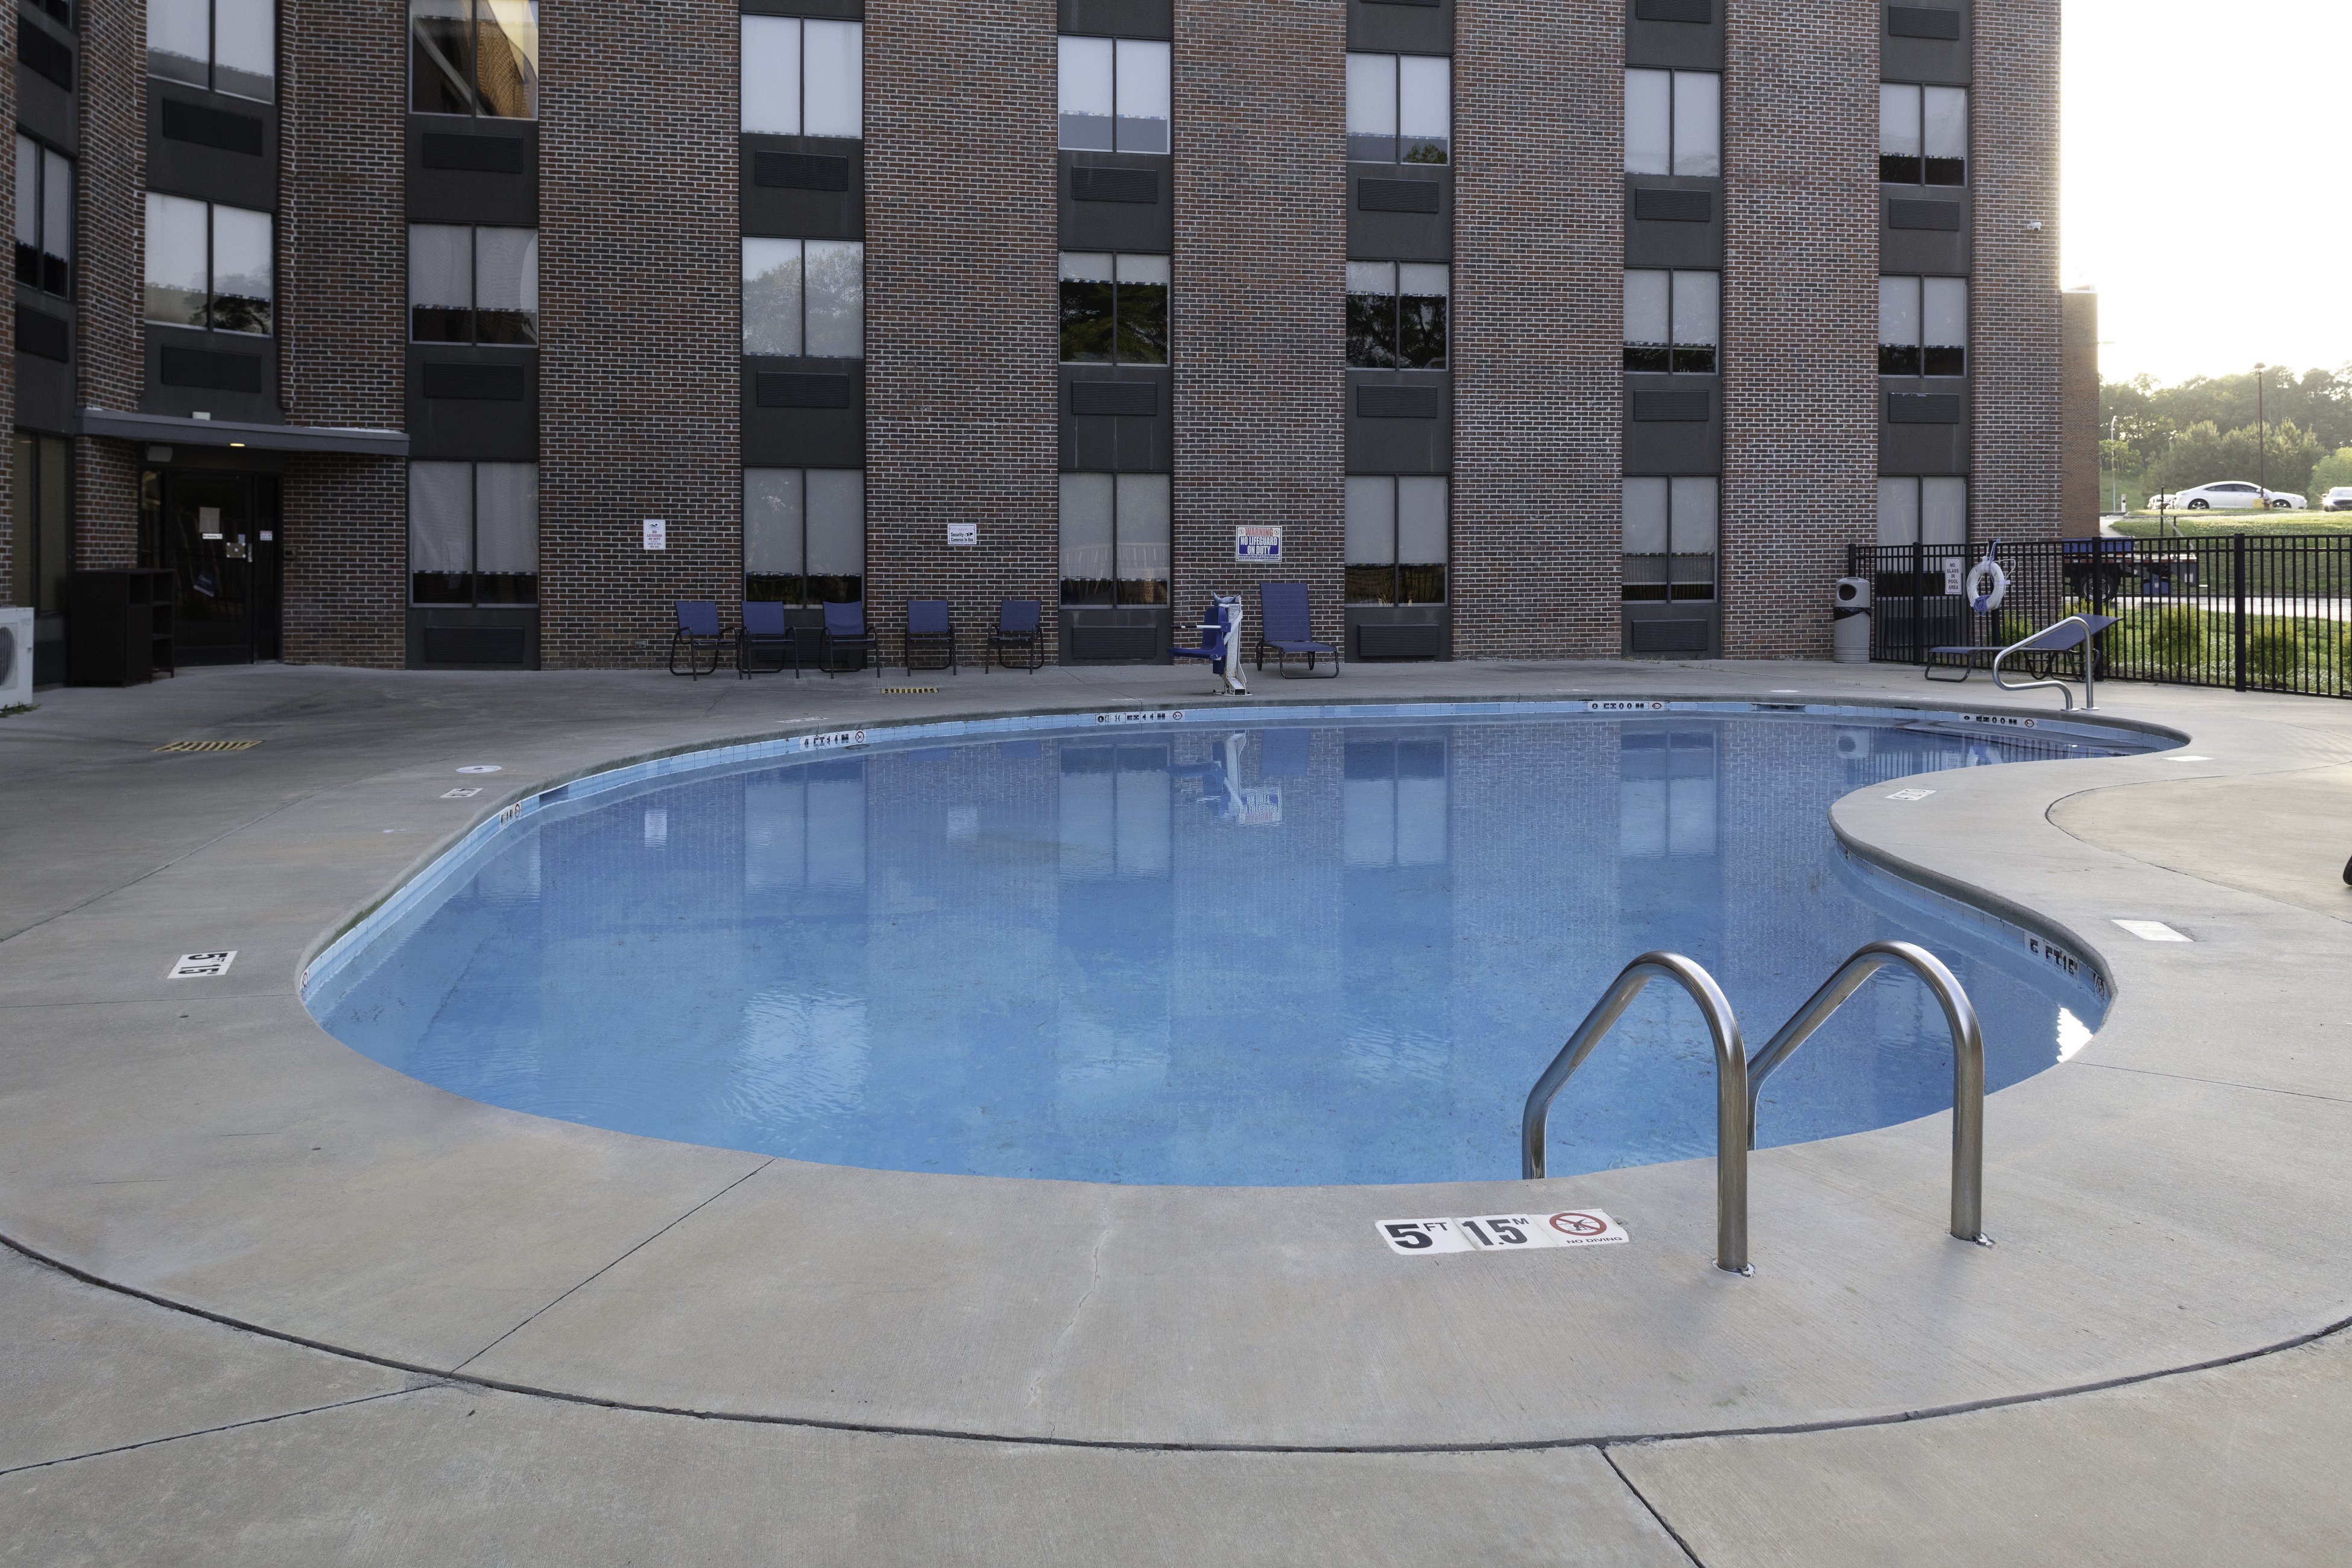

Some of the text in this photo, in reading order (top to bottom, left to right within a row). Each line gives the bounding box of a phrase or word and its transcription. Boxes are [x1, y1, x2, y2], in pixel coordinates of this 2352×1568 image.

[1245, 528, 1273, 537] WARNING
[1241, 536, 1277, 546] NO LIFEGUARD
[1247, 545, 1271, 554] ON DUTY
[1383, 1217, 1529, 1250] 5 FT 1.5 M
